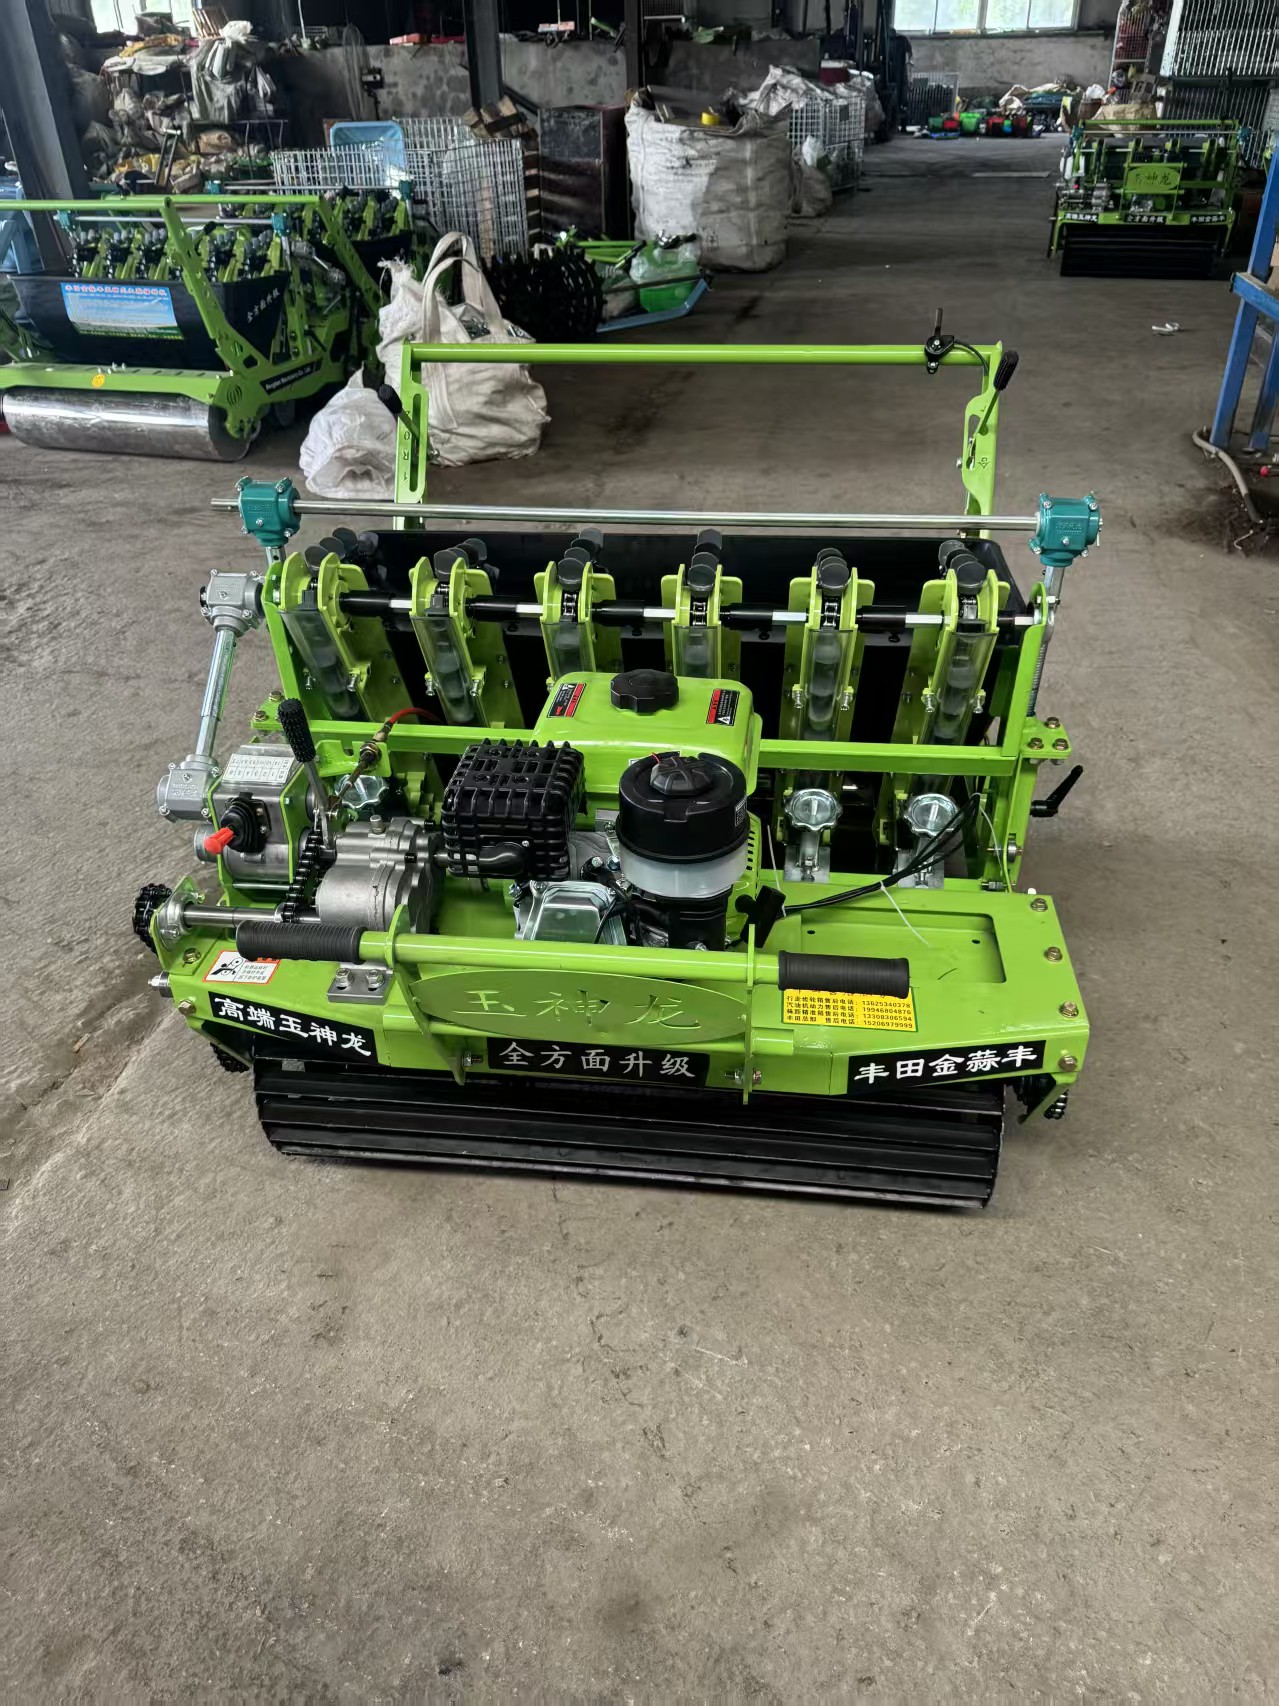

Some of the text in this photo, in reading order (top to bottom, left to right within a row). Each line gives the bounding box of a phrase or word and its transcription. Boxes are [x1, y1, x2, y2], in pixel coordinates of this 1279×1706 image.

[214, 997, 372, 1057] 高端玉神龙
[454, 989, 702, 1029] 玉神龙
[499, 1041, 696, 1078] 全方面升级
[853, 1045, 1038, 1084] 丰田金蒜丰
